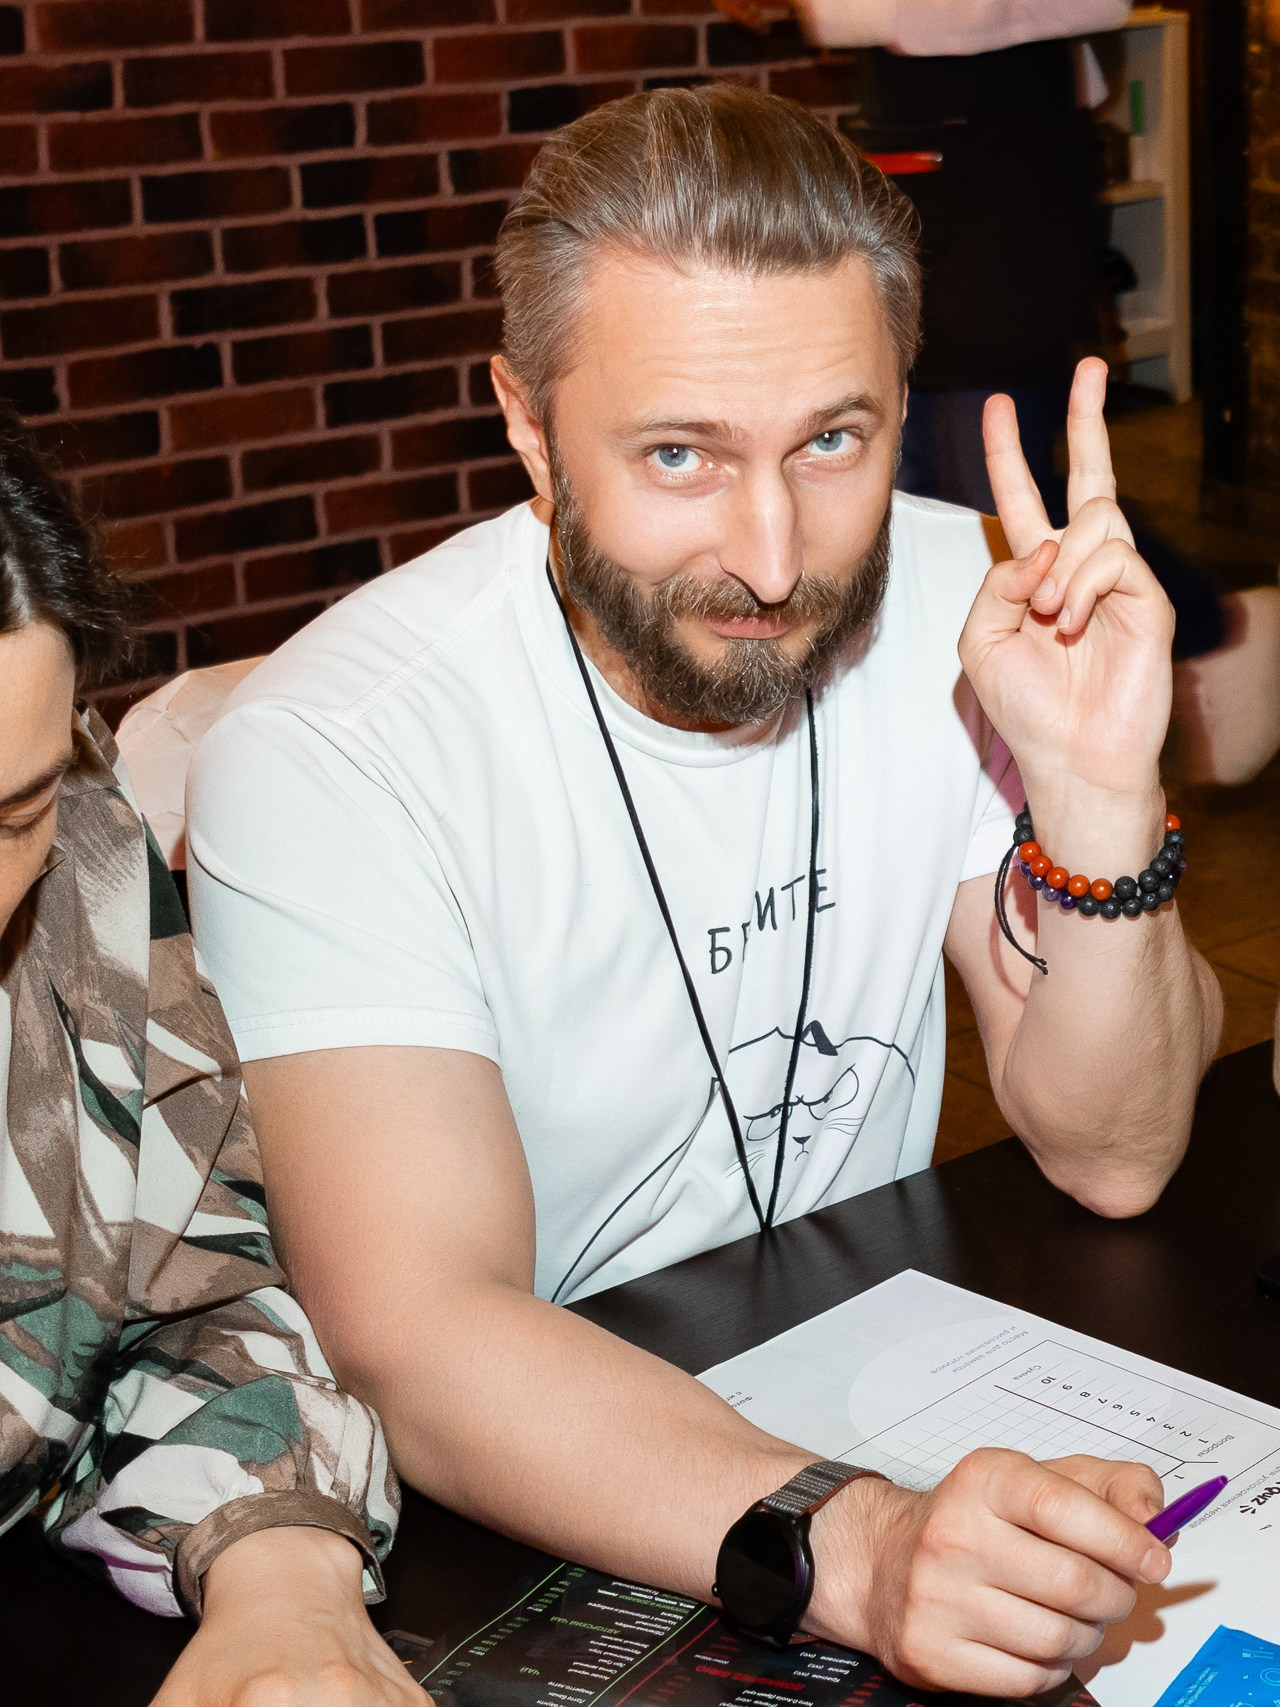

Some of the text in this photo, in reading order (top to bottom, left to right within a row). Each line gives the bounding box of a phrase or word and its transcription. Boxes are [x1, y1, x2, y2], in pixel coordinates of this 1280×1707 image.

[964, 1329, 1010, 1356] рисования
[952, 1330, 1029, 1373] Место для заметок
[930, 1355, 965, 1374] котиков
[1013, 1364, 1042, 1381] Сумма
[1041, 1375, 1057, 1385] 10
[1062, 1383, 1073, 1391] 9
[1112, 1403, 1123, 1411] 6
[1130, 1409, 1141, 1417] 5
[1197, 1434, 1235, 1457] Вопросы
[1221, 1474, 1269, 1509] успокоения
[1189, 1506, 1222, 1528] нервов
[569, 1620, 620, 1634] АВТОРСКИЙ
[518, 1666, 542, 1675] ЧАЙ
[564, 1685, 595, 1694] Амаретто
